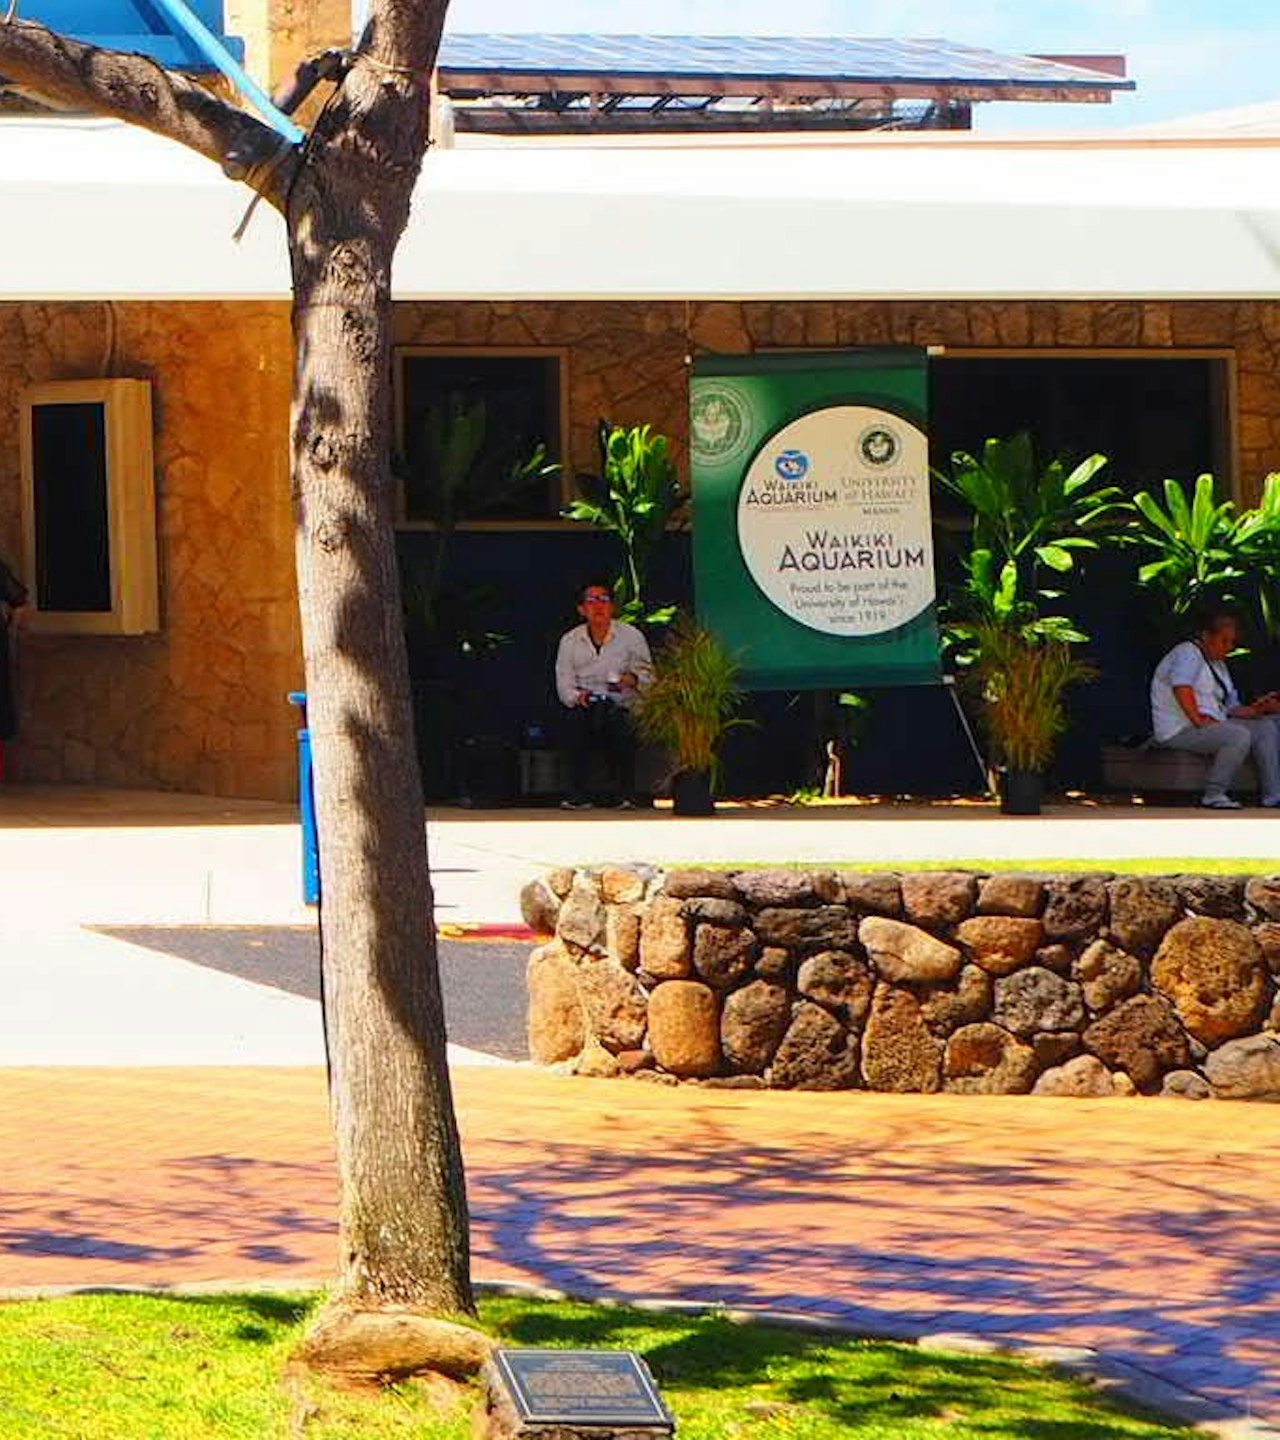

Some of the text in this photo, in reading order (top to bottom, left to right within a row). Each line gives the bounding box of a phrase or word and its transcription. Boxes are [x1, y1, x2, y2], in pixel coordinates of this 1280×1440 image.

[746, 490, 838, 506] AQUARIUM
[778, 544, 925, 572] AQUARIUM
[790, 580, 821, 593] Proud
[794, 598, 846, 610] University
